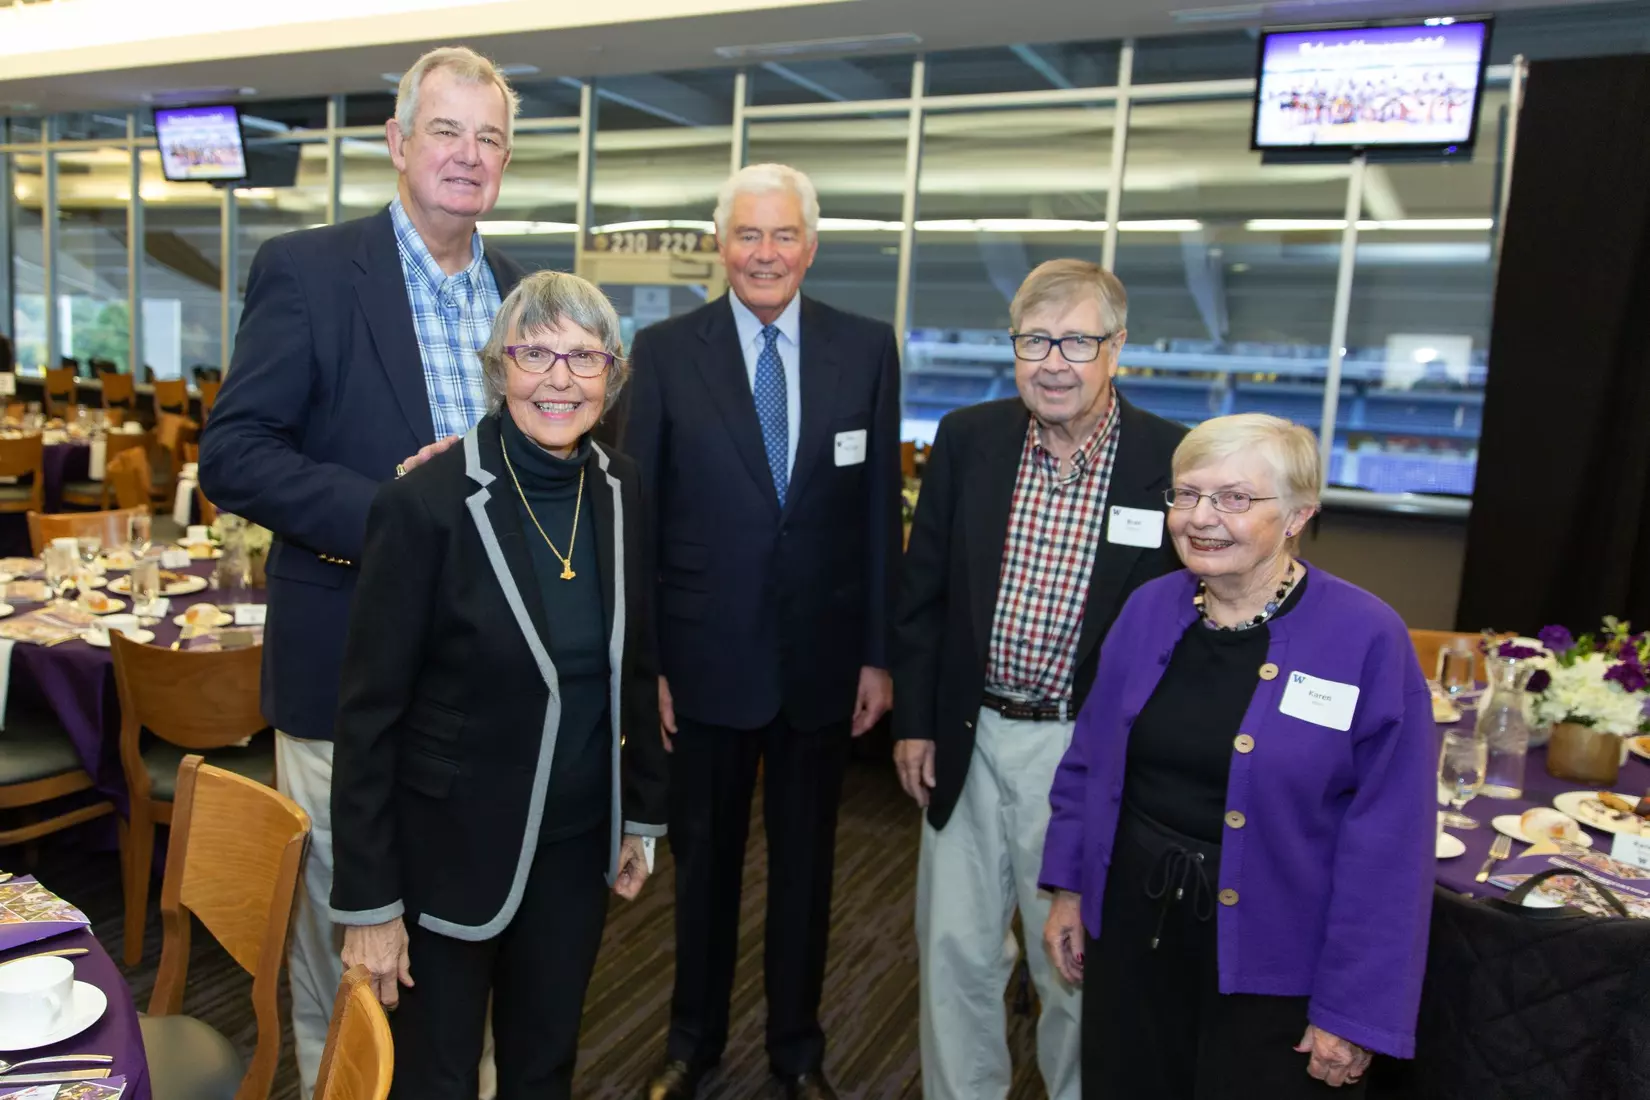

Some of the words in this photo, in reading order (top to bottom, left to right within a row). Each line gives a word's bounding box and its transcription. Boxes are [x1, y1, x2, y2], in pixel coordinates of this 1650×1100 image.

[611, 232, 648, 253] 230
[659, 232, 697, 254] 229
[1293, 673, 1306, 684] W
[1308, 690, 1332, 702] Karen
